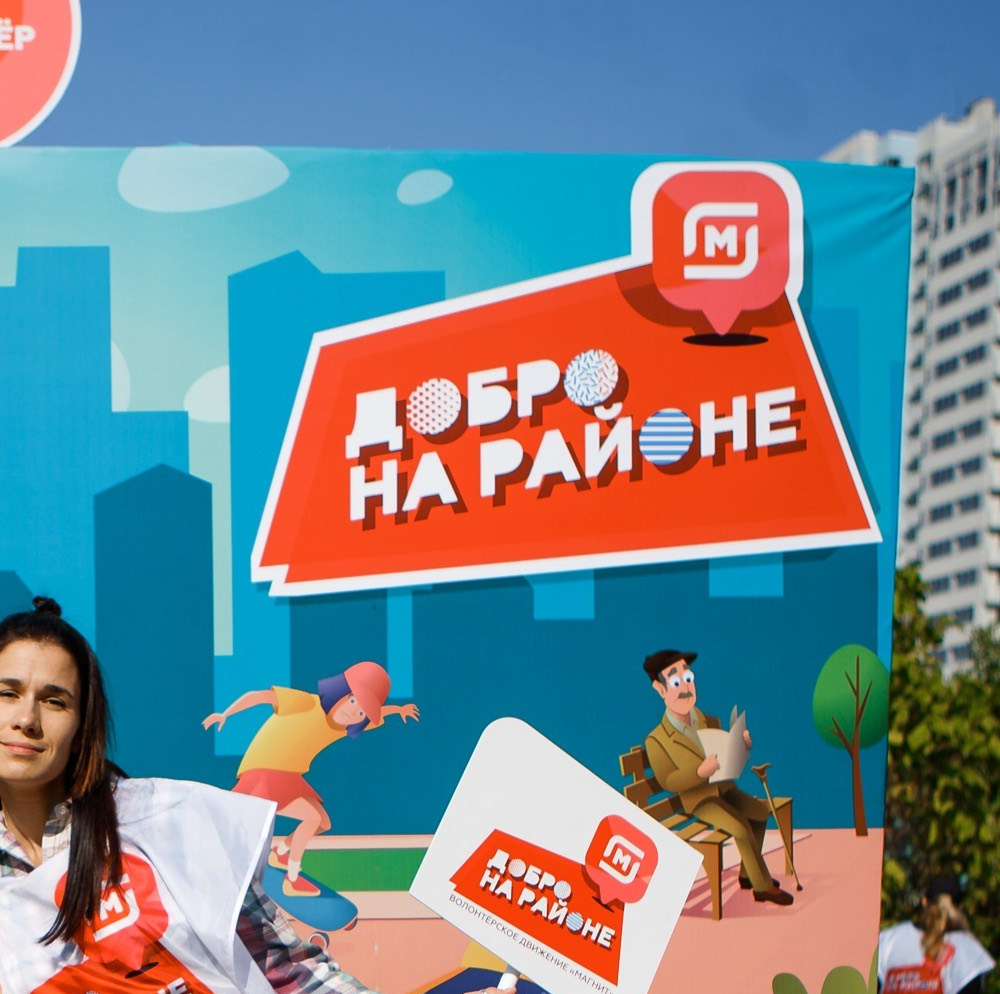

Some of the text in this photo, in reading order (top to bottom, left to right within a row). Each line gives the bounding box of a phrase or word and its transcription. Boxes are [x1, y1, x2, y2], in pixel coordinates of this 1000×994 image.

[346, 349, 619, 459] ДОБРО
[350, 386, 798, 521] НА РАЙОНЕ
[479, 869, 616, 948] НА РАЙОНЕ
[487, 848, 572, 901] ДОБРО
[518, 937, 569, 971] ДВИЖЕНИЕ
